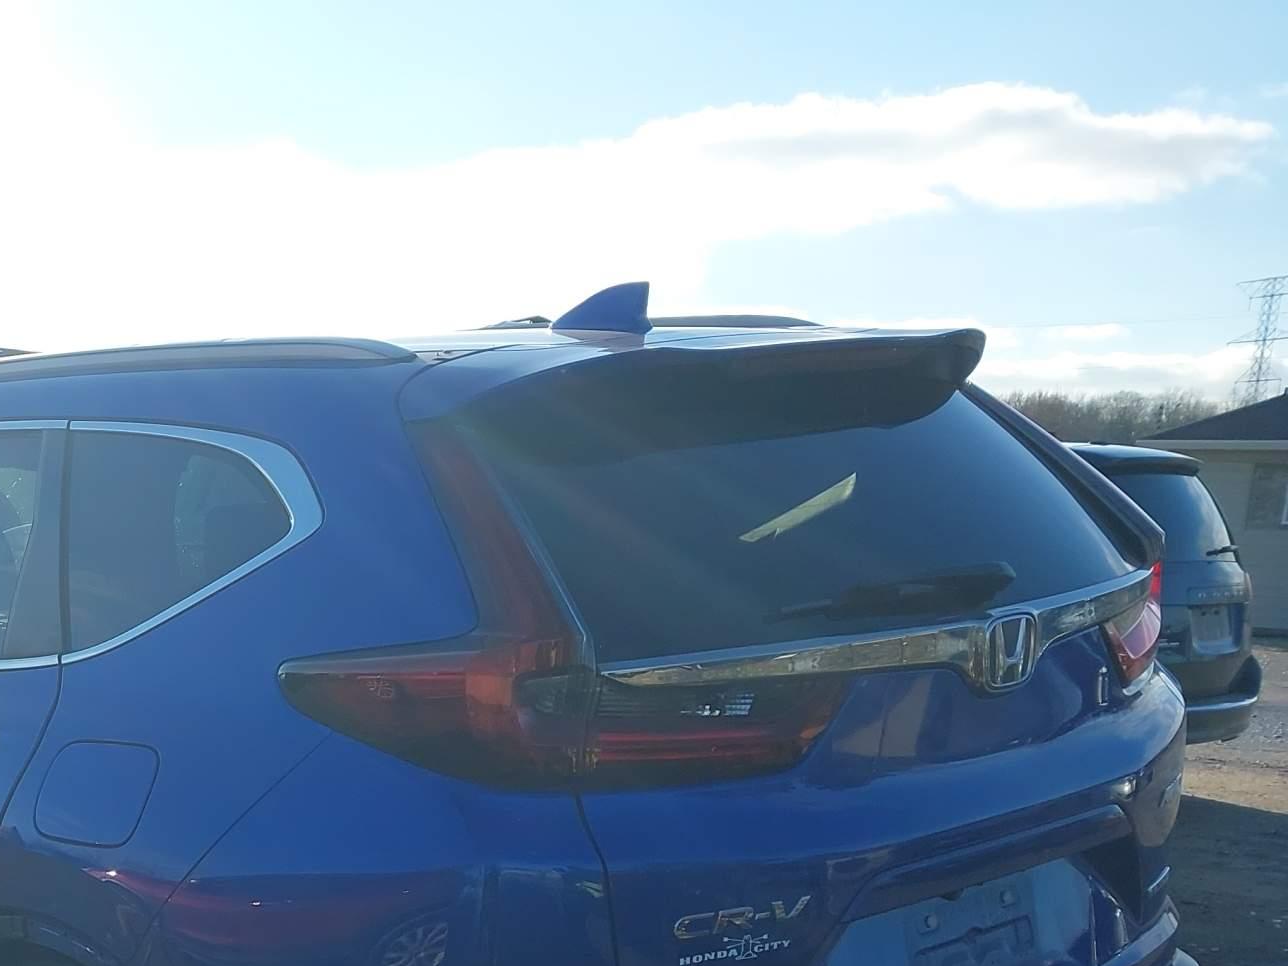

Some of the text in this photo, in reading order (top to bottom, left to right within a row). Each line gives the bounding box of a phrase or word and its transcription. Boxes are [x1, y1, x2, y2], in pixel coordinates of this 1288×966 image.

[673, 895, 812, 940] CR-V
[679, 938, 792, 966] HONDA CITY
